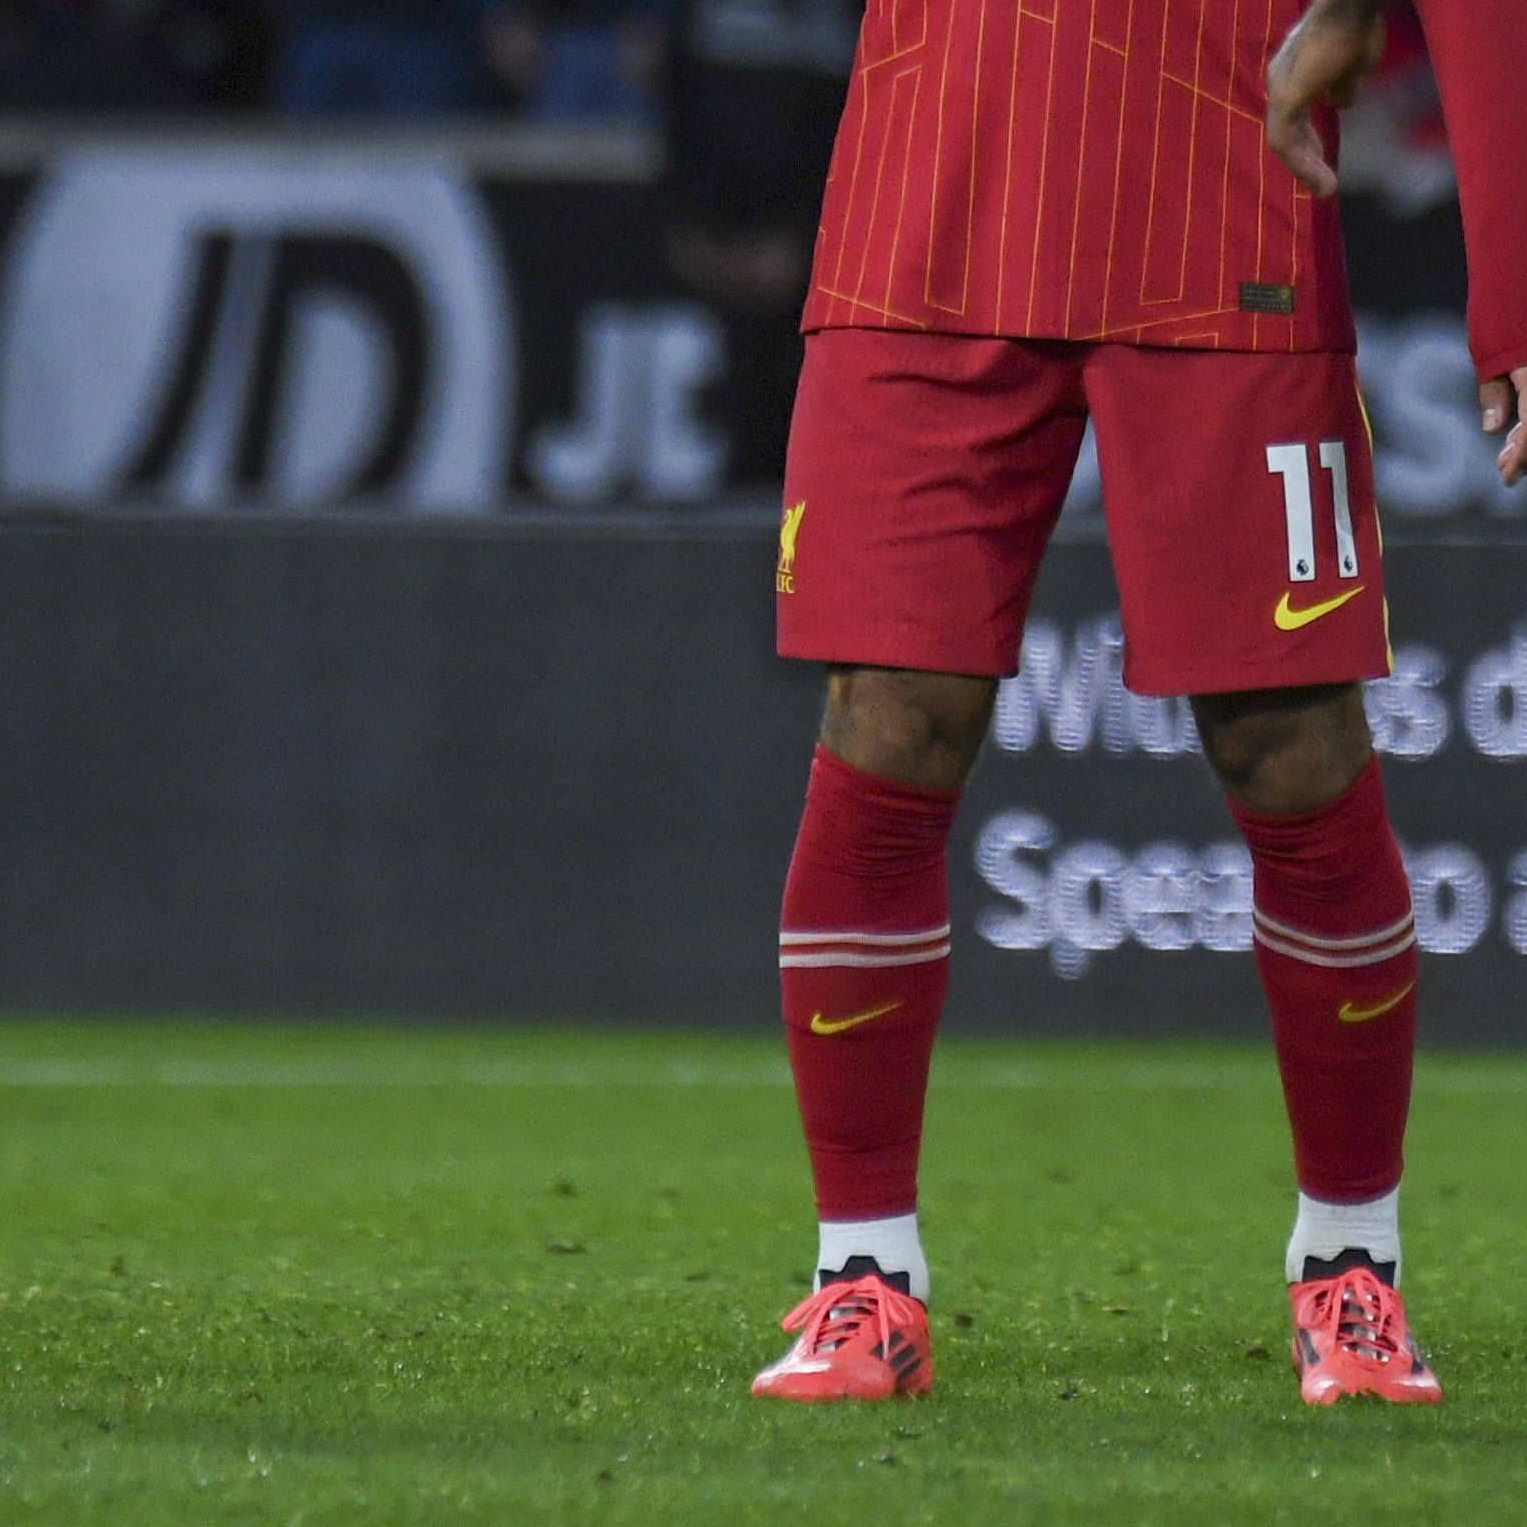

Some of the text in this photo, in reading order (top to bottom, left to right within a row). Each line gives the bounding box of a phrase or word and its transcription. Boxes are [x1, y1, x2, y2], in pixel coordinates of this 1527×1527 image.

[1266, 440, 1359, 583] 11
[974, 807, 1254, 980] Spea
[1398, 839, 1491, 957] o
